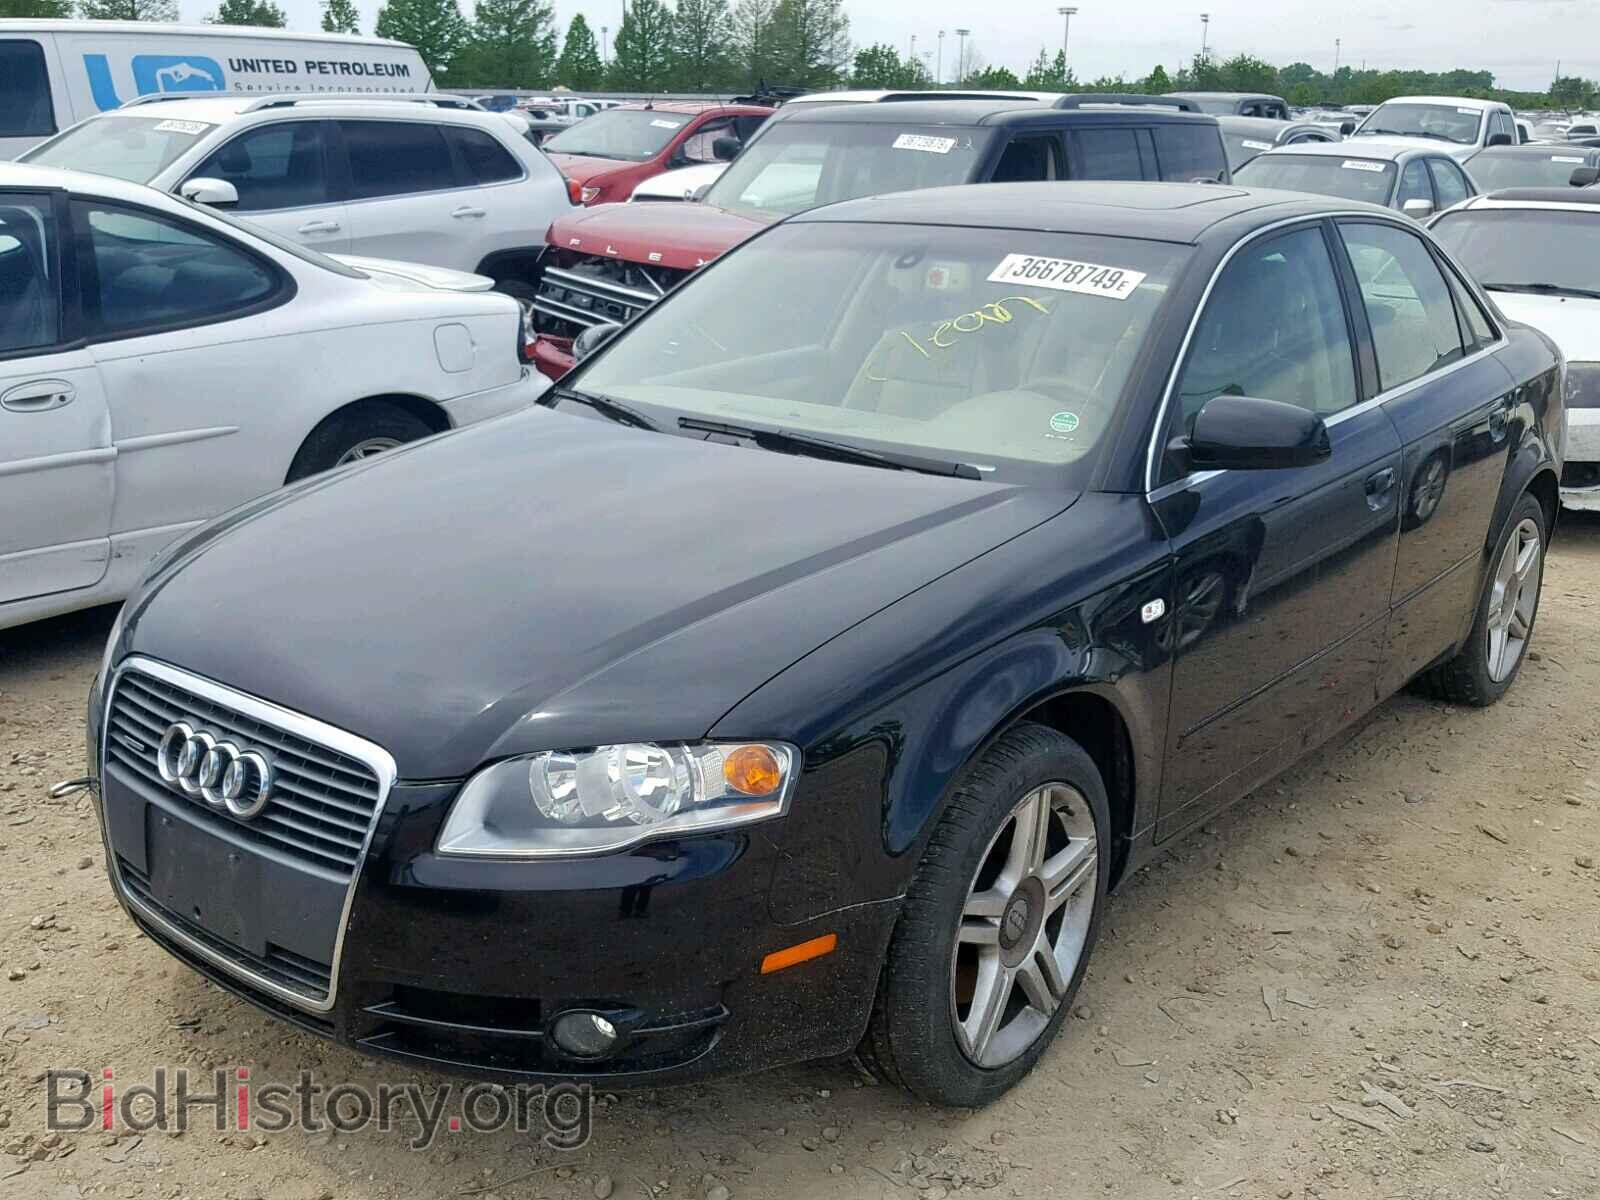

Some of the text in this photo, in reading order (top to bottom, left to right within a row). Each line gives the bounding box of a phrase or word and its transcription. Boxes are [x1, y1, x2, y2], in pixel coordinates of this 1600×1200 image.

[228, 58, 410, 77] UNITED PETROLEUM
[234, 82, 301, 92] Service
